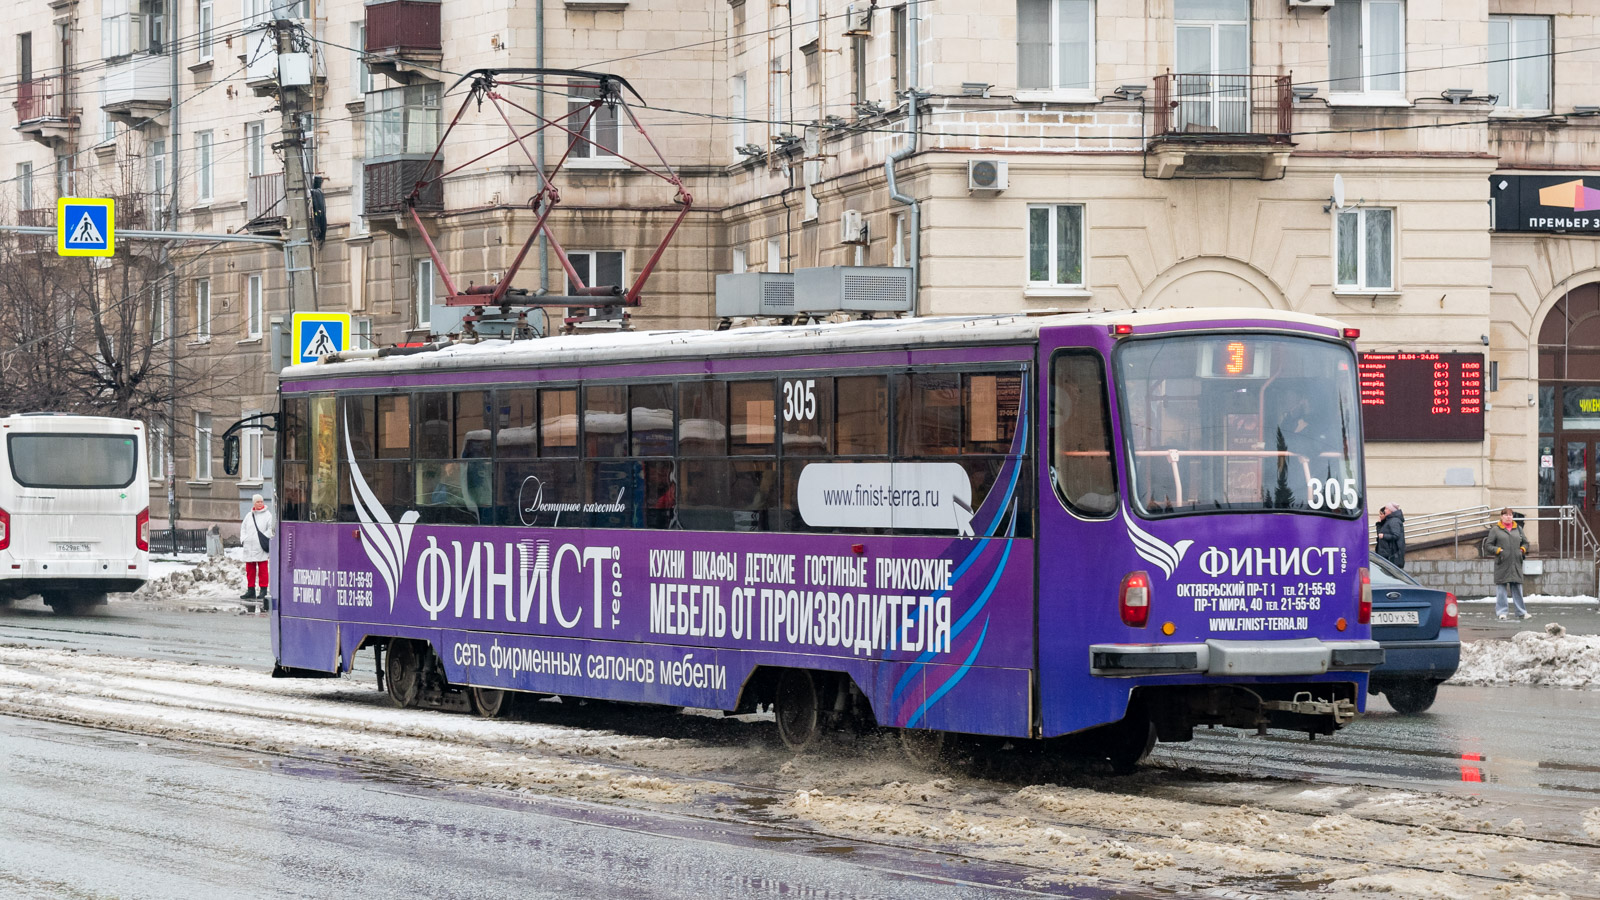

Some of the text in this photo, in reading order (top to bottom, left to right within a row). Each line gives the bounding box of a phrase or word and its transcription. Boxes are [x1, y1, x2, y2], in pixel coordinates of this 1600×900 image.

[1529, 217, 1589, 228] ПРЕМЬЕР
[1226, 342, 1244, 373] 3
[1433, 362, 1449, 370] (6+)
[1433, 371, 1449, 379] (6+)
[1433, 380, 1449, 388] (6+)
[783, 379, 816, 422] 305
[1433, 388, 1449, 397] (6+)
[1433, 397, 1449, 405] (6+)
[518, 475, 626, 527] Доступное качество
[823, 482, 940, 508] www.finist-terra.ru
[1307, 477, 1359, 510] 305
[649, 549, 953, 591] КУХНИ ШКАФЫ ДЕТСКИЕ ГОСТИНЫЕ ПРИХОЖИЕ
[1199, 546, 1339, 577] ФИНИСТ
[337, 571, 348, 587] ТЕЛ.
[349, 572, 373, 588] 21-55-93
[416, 535, 612, 630] ФИНИСТ
[610, 545, 623, 630] терра
[1176, 581, 1245, 597] ОКТЯБРЬСКИЙ
[1246, 583, 1269, 597] ПР-Т
[1270, 583, 1276, 597] 1
[1297, 582, 1336, 596] 21-55-93
[316, 588, 322, 604] 40
[337, 589, 348, 605] ТЕЛ.
[349, 590, 373, 607] 21-55-83
[1194, 598, 1217, 612] ПР-Т
[1218, 598, 1249, 613] МИРА,
[1250, 597, 1263, 611] 40
[1280, 597, 1321, 610] 21-55-83
[650, 583, 951, 656] МЕБЕЛЬ ОТ ПРОИЗВОДИТЕЛЯ
[1209, 617, 1308, 631] WWW.FINIST-TERRA.RU
[1407, 612, 1416, 620] 96
[454, 638, 727, 690] сеть фирменных салонов мебели
